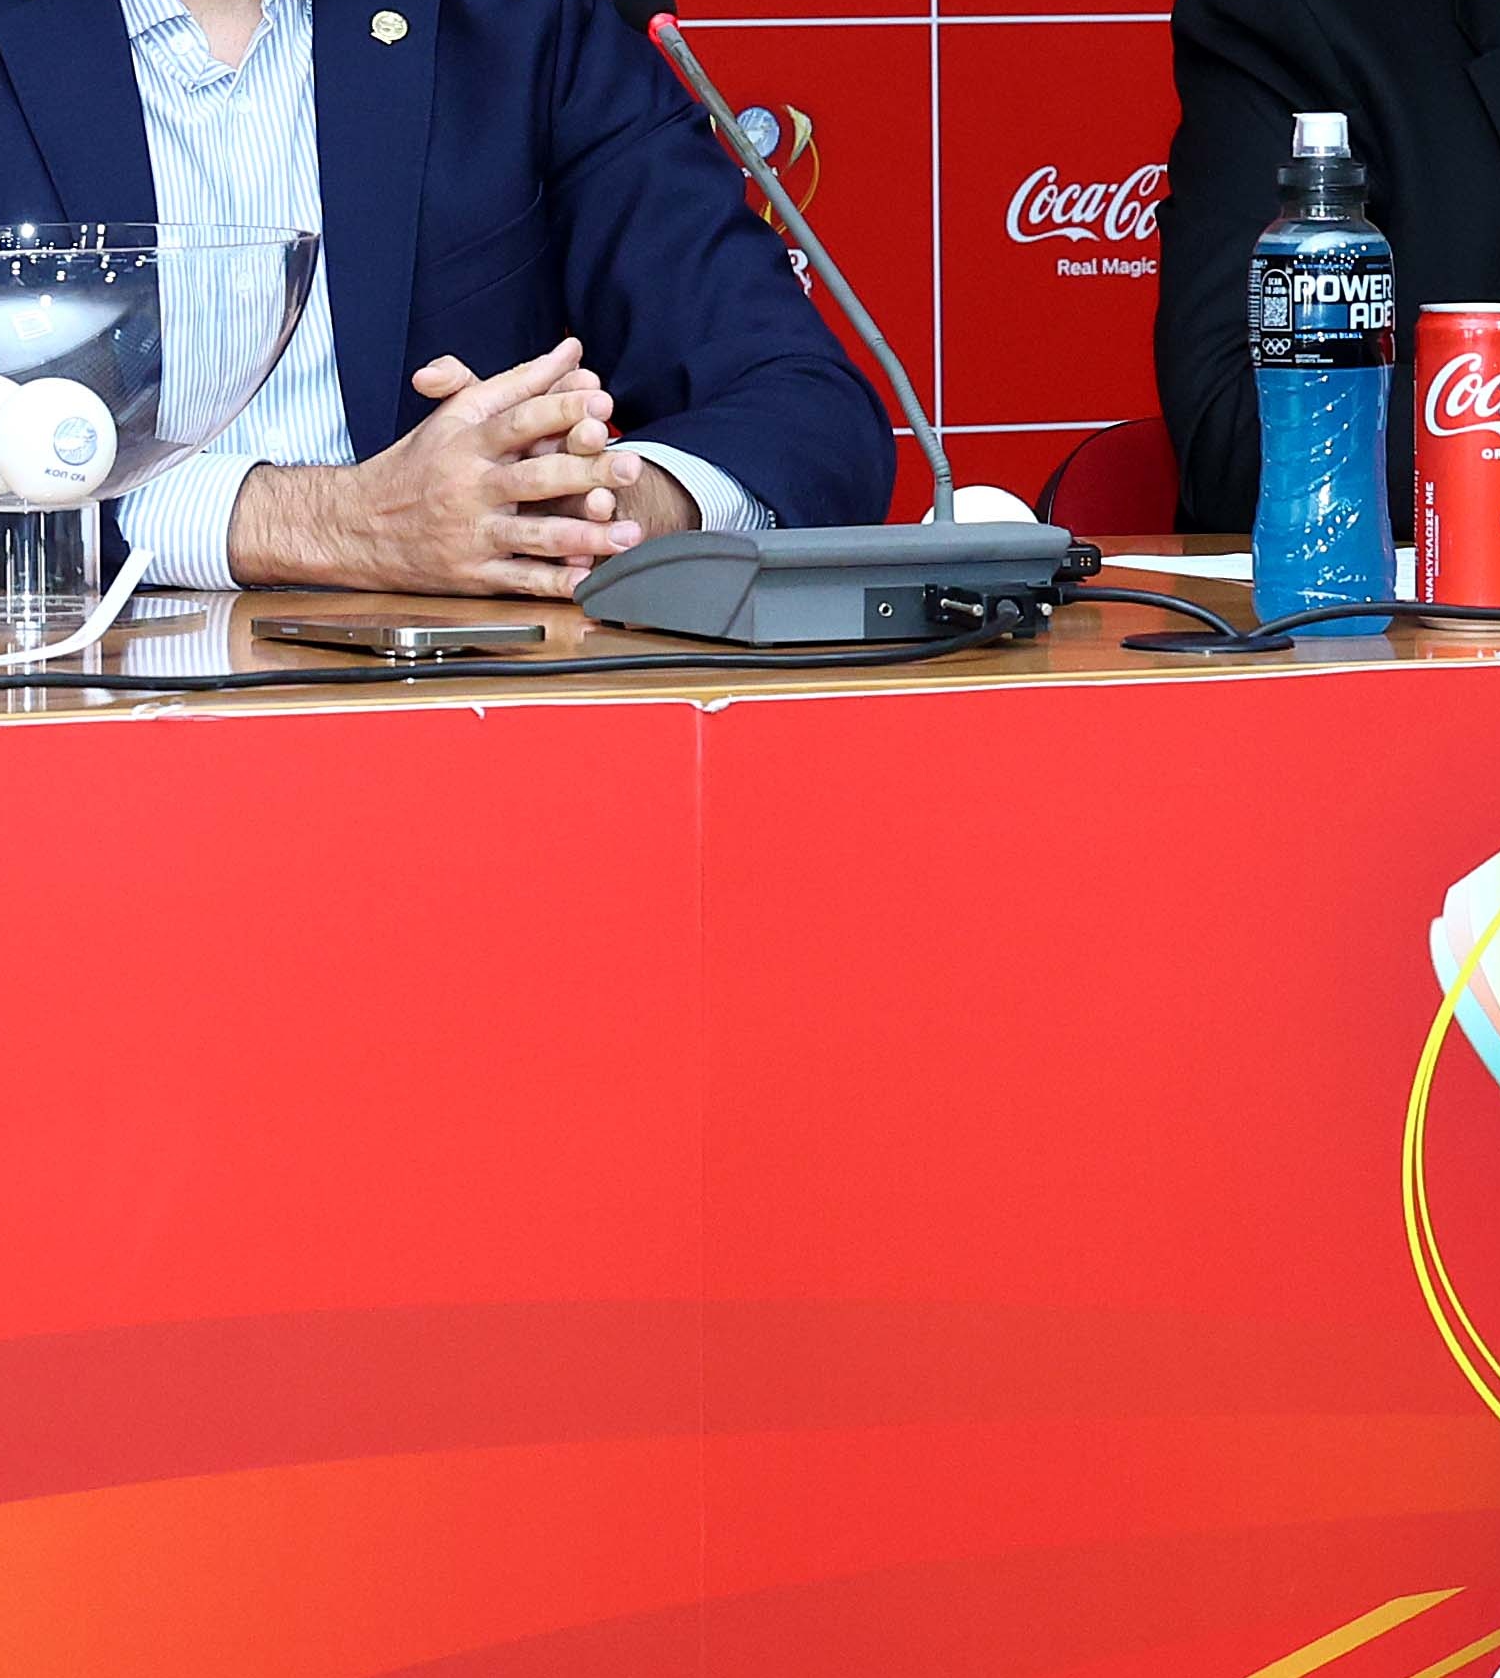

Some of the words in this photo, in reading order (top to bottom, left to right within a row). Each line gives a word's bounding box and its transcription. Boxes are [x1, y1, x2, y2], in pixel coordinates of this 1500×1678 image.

[1006, 164, 1169, 243] Coca-Co
[1057, 258, 1099, 276] Real
[1101, 256, 1158, 278] Magic
[1294, 274, 1392, 302] POWER
[1349, 301, 1393, 330] ADE
